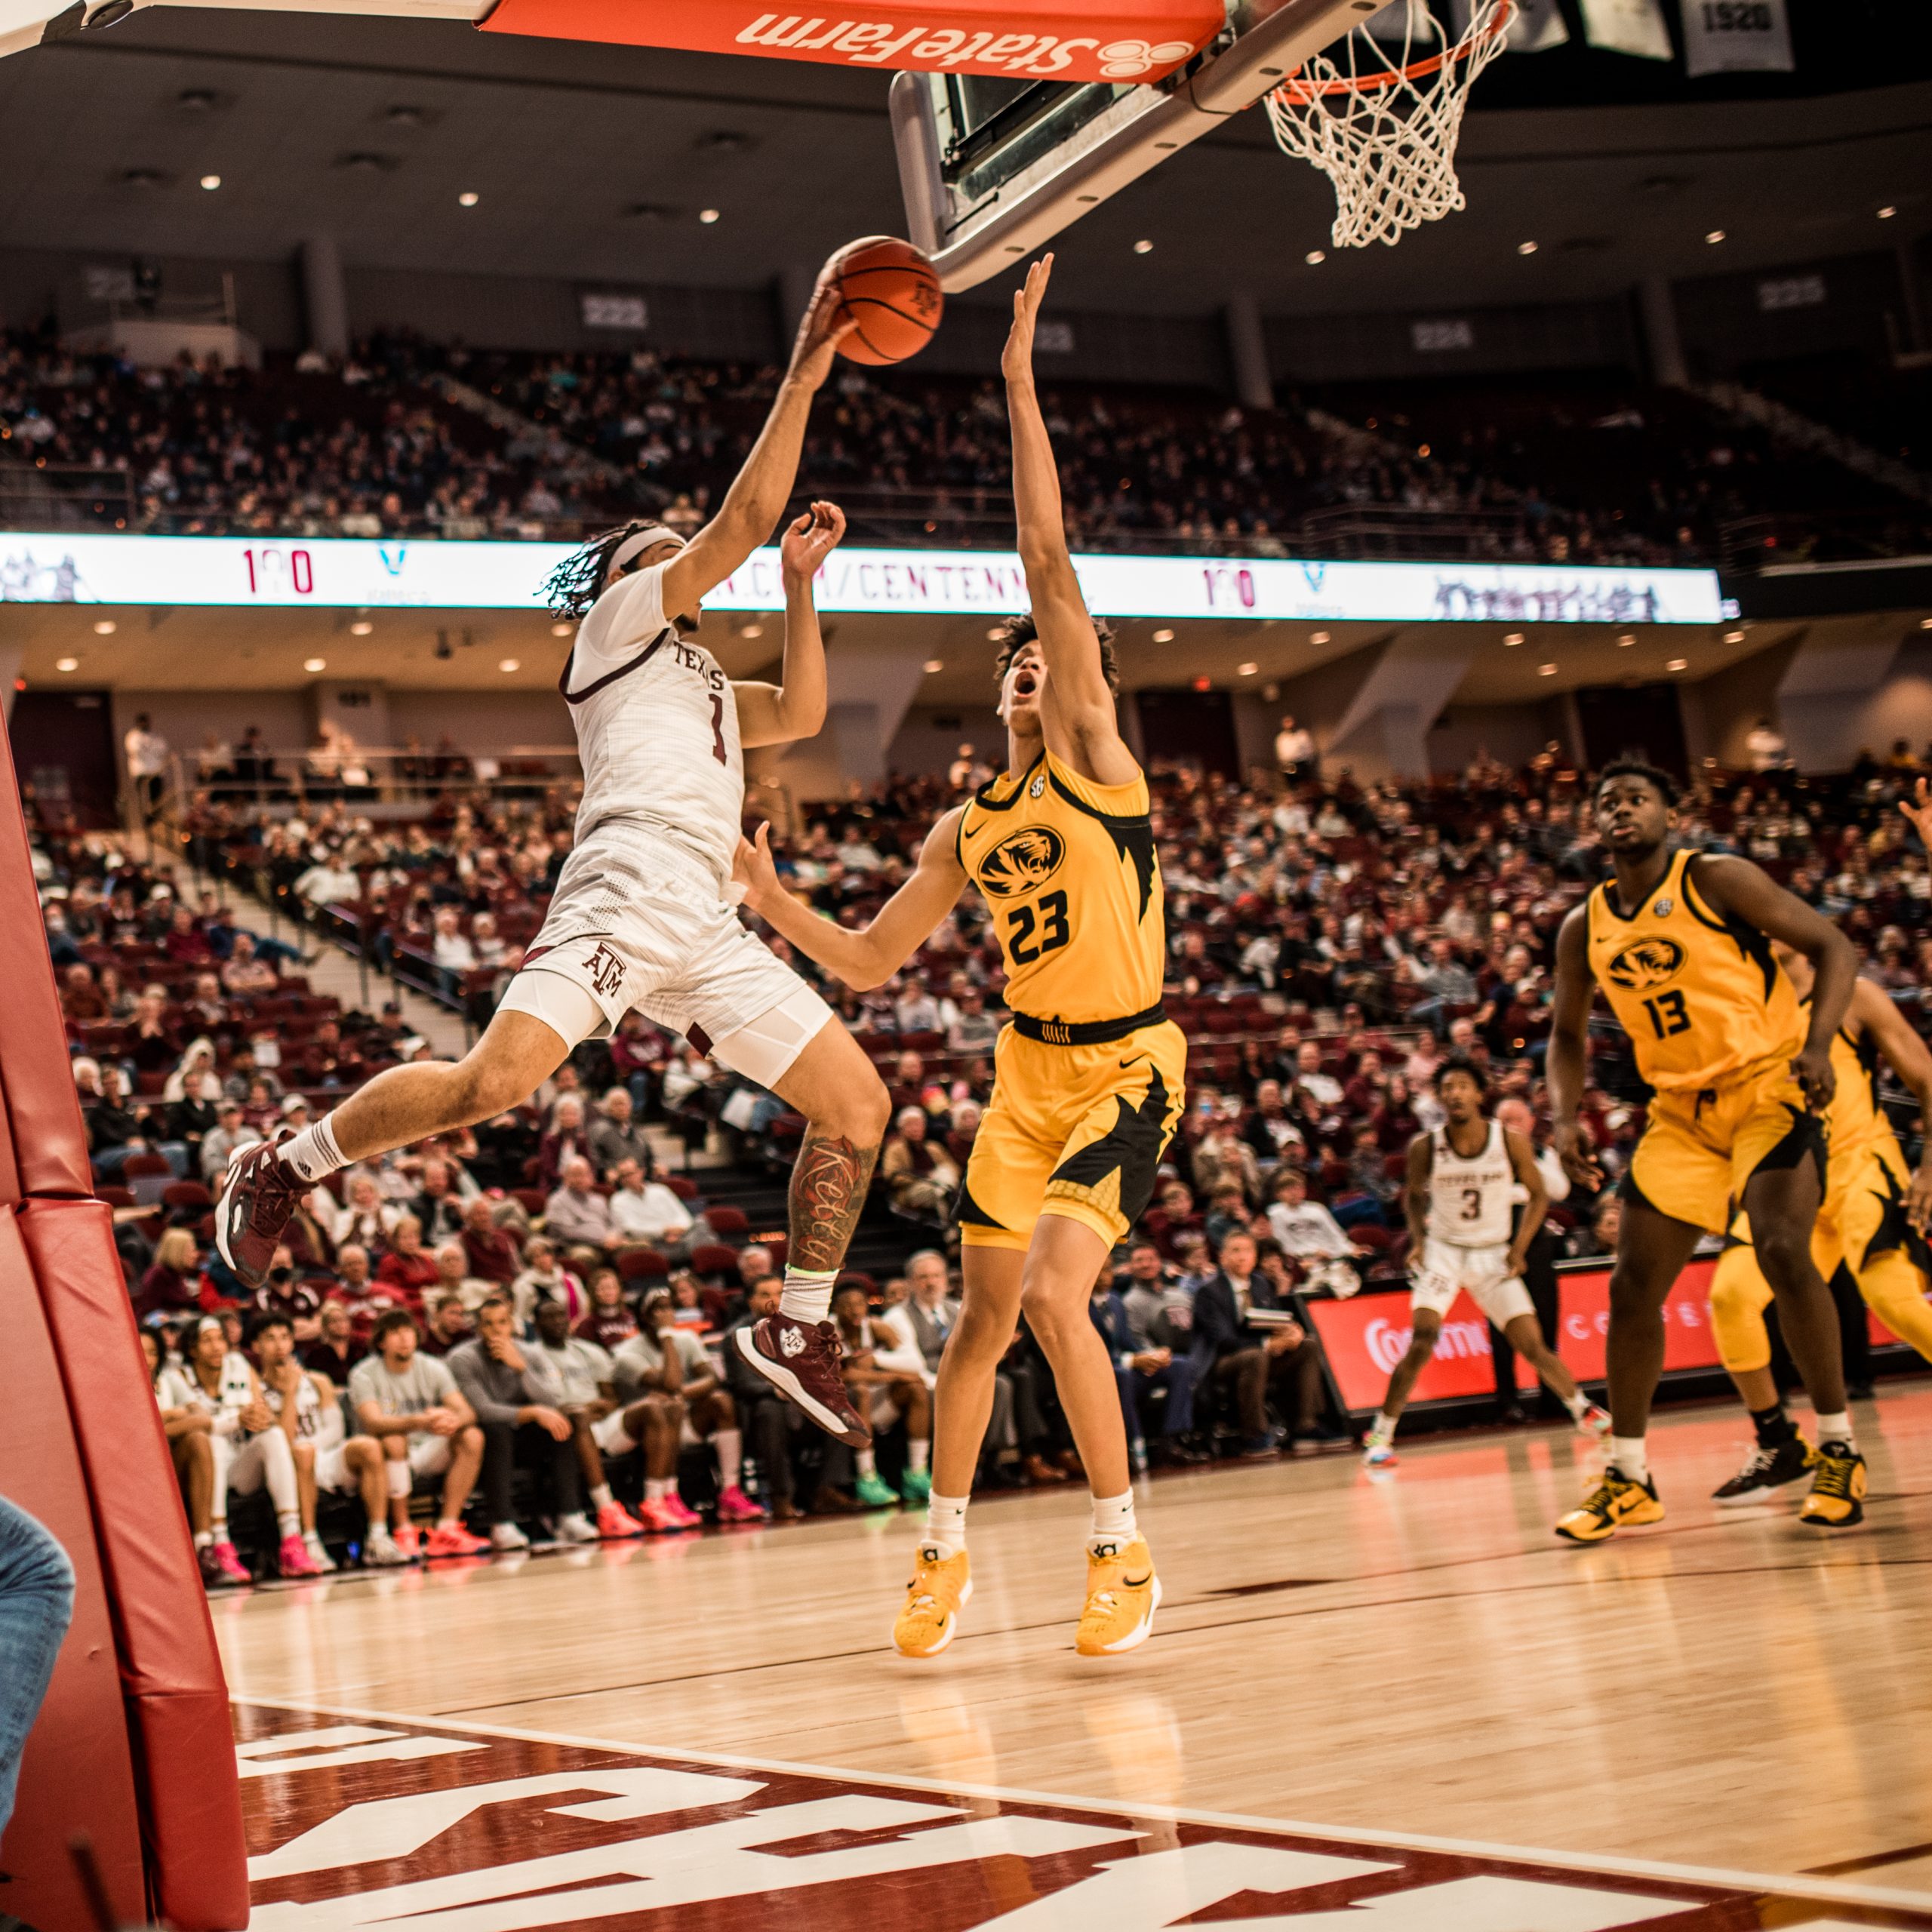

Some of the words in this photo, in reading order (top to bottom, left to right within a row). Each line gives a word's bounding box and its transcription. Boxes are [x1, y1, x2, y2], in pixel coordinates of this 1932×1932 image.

[672, 640, 724, 691] TEXS
[708, 693, 728, 767] 1
[1008, 889, 1069, 967] 23
[1641, 989, 1691, 1040] 13
[1460, 1189, 1481, 1220] 3
